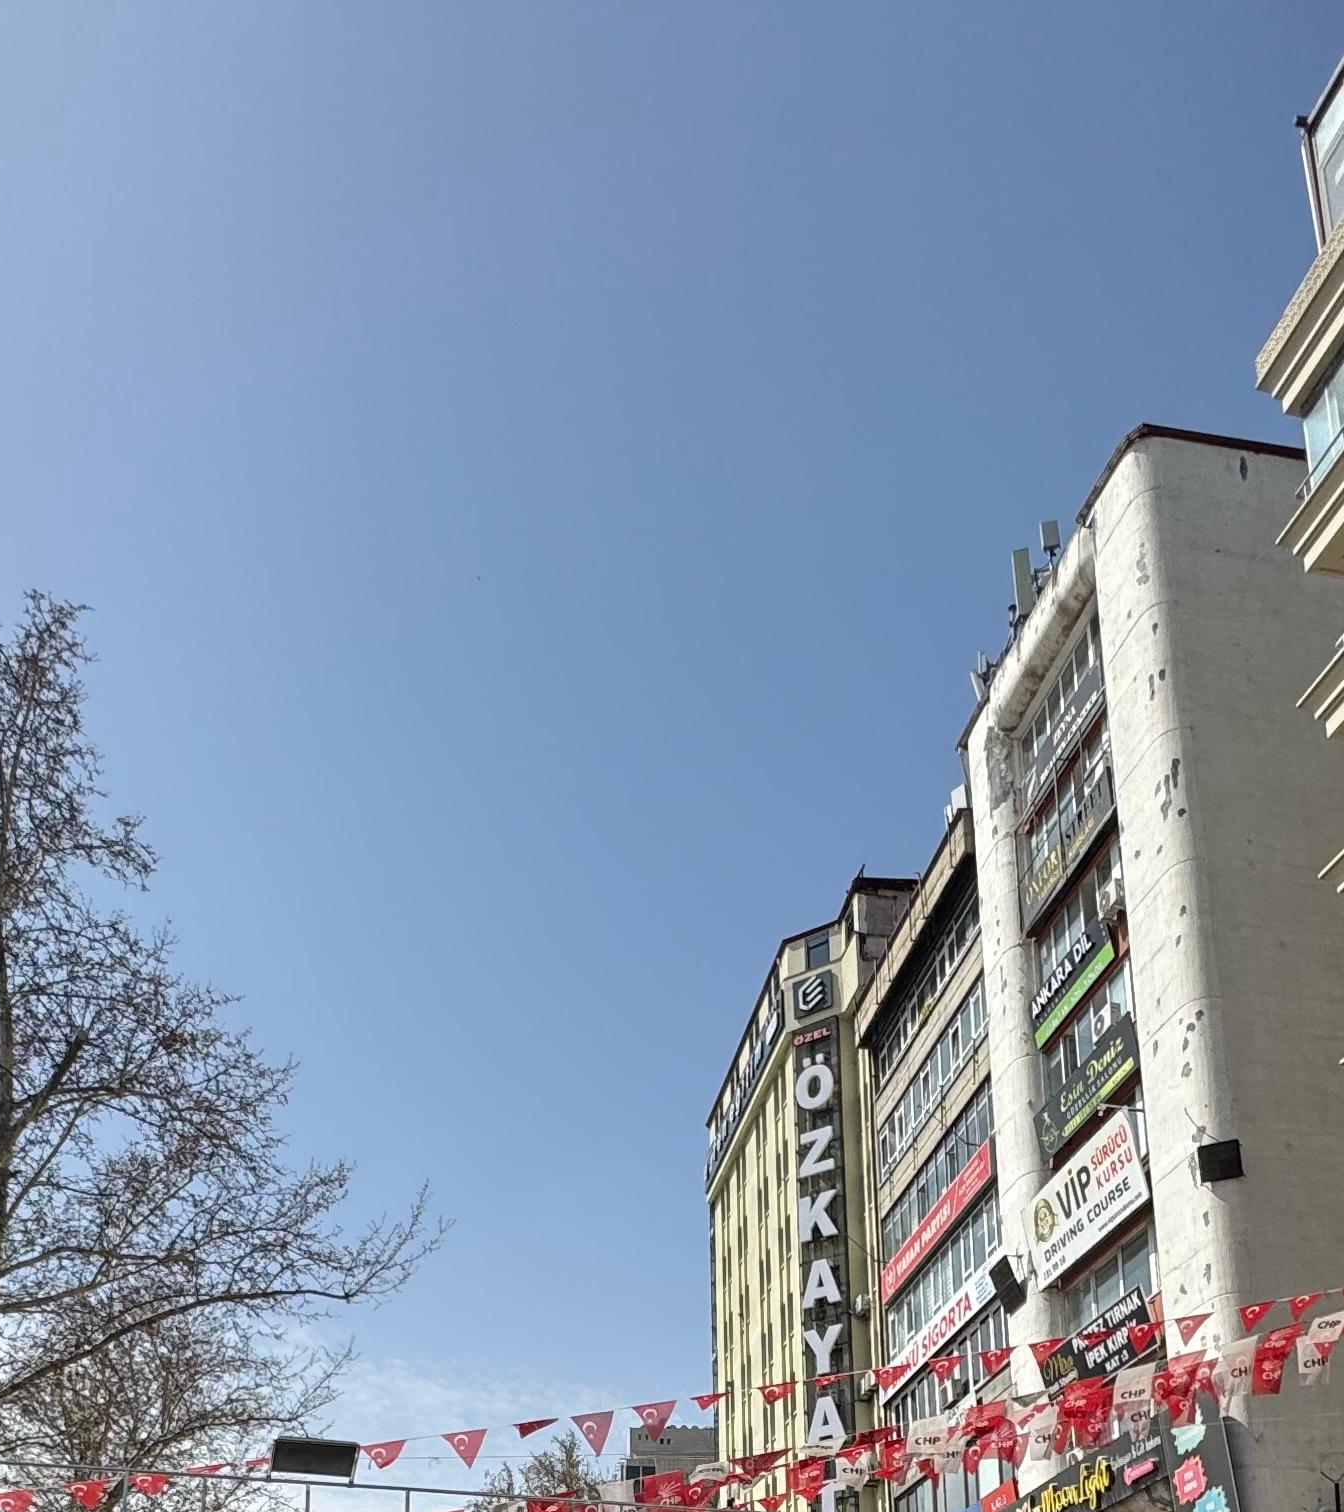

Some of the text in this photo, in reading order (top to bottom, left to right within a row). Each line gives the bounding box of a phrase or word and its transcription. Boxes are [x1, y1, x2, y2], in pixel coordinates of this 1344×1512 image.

[1031, 958, 1073, 1020] ANKARA
[1073, 933, 1093, 964] DİL
[792, 1027, 831, 1047] ÖZEL
[1094, 1146, 1133, 1191] KURSU
[1087, 1175, 1132, 1224] COURSE
[1104, 1290, 1142, 1328] TIRNAK
[1231, 1366, 1248, 1378] CH
[1121, 1389, 1146, 1400] CHP
[915, 1436, 941, 1446] CHP
